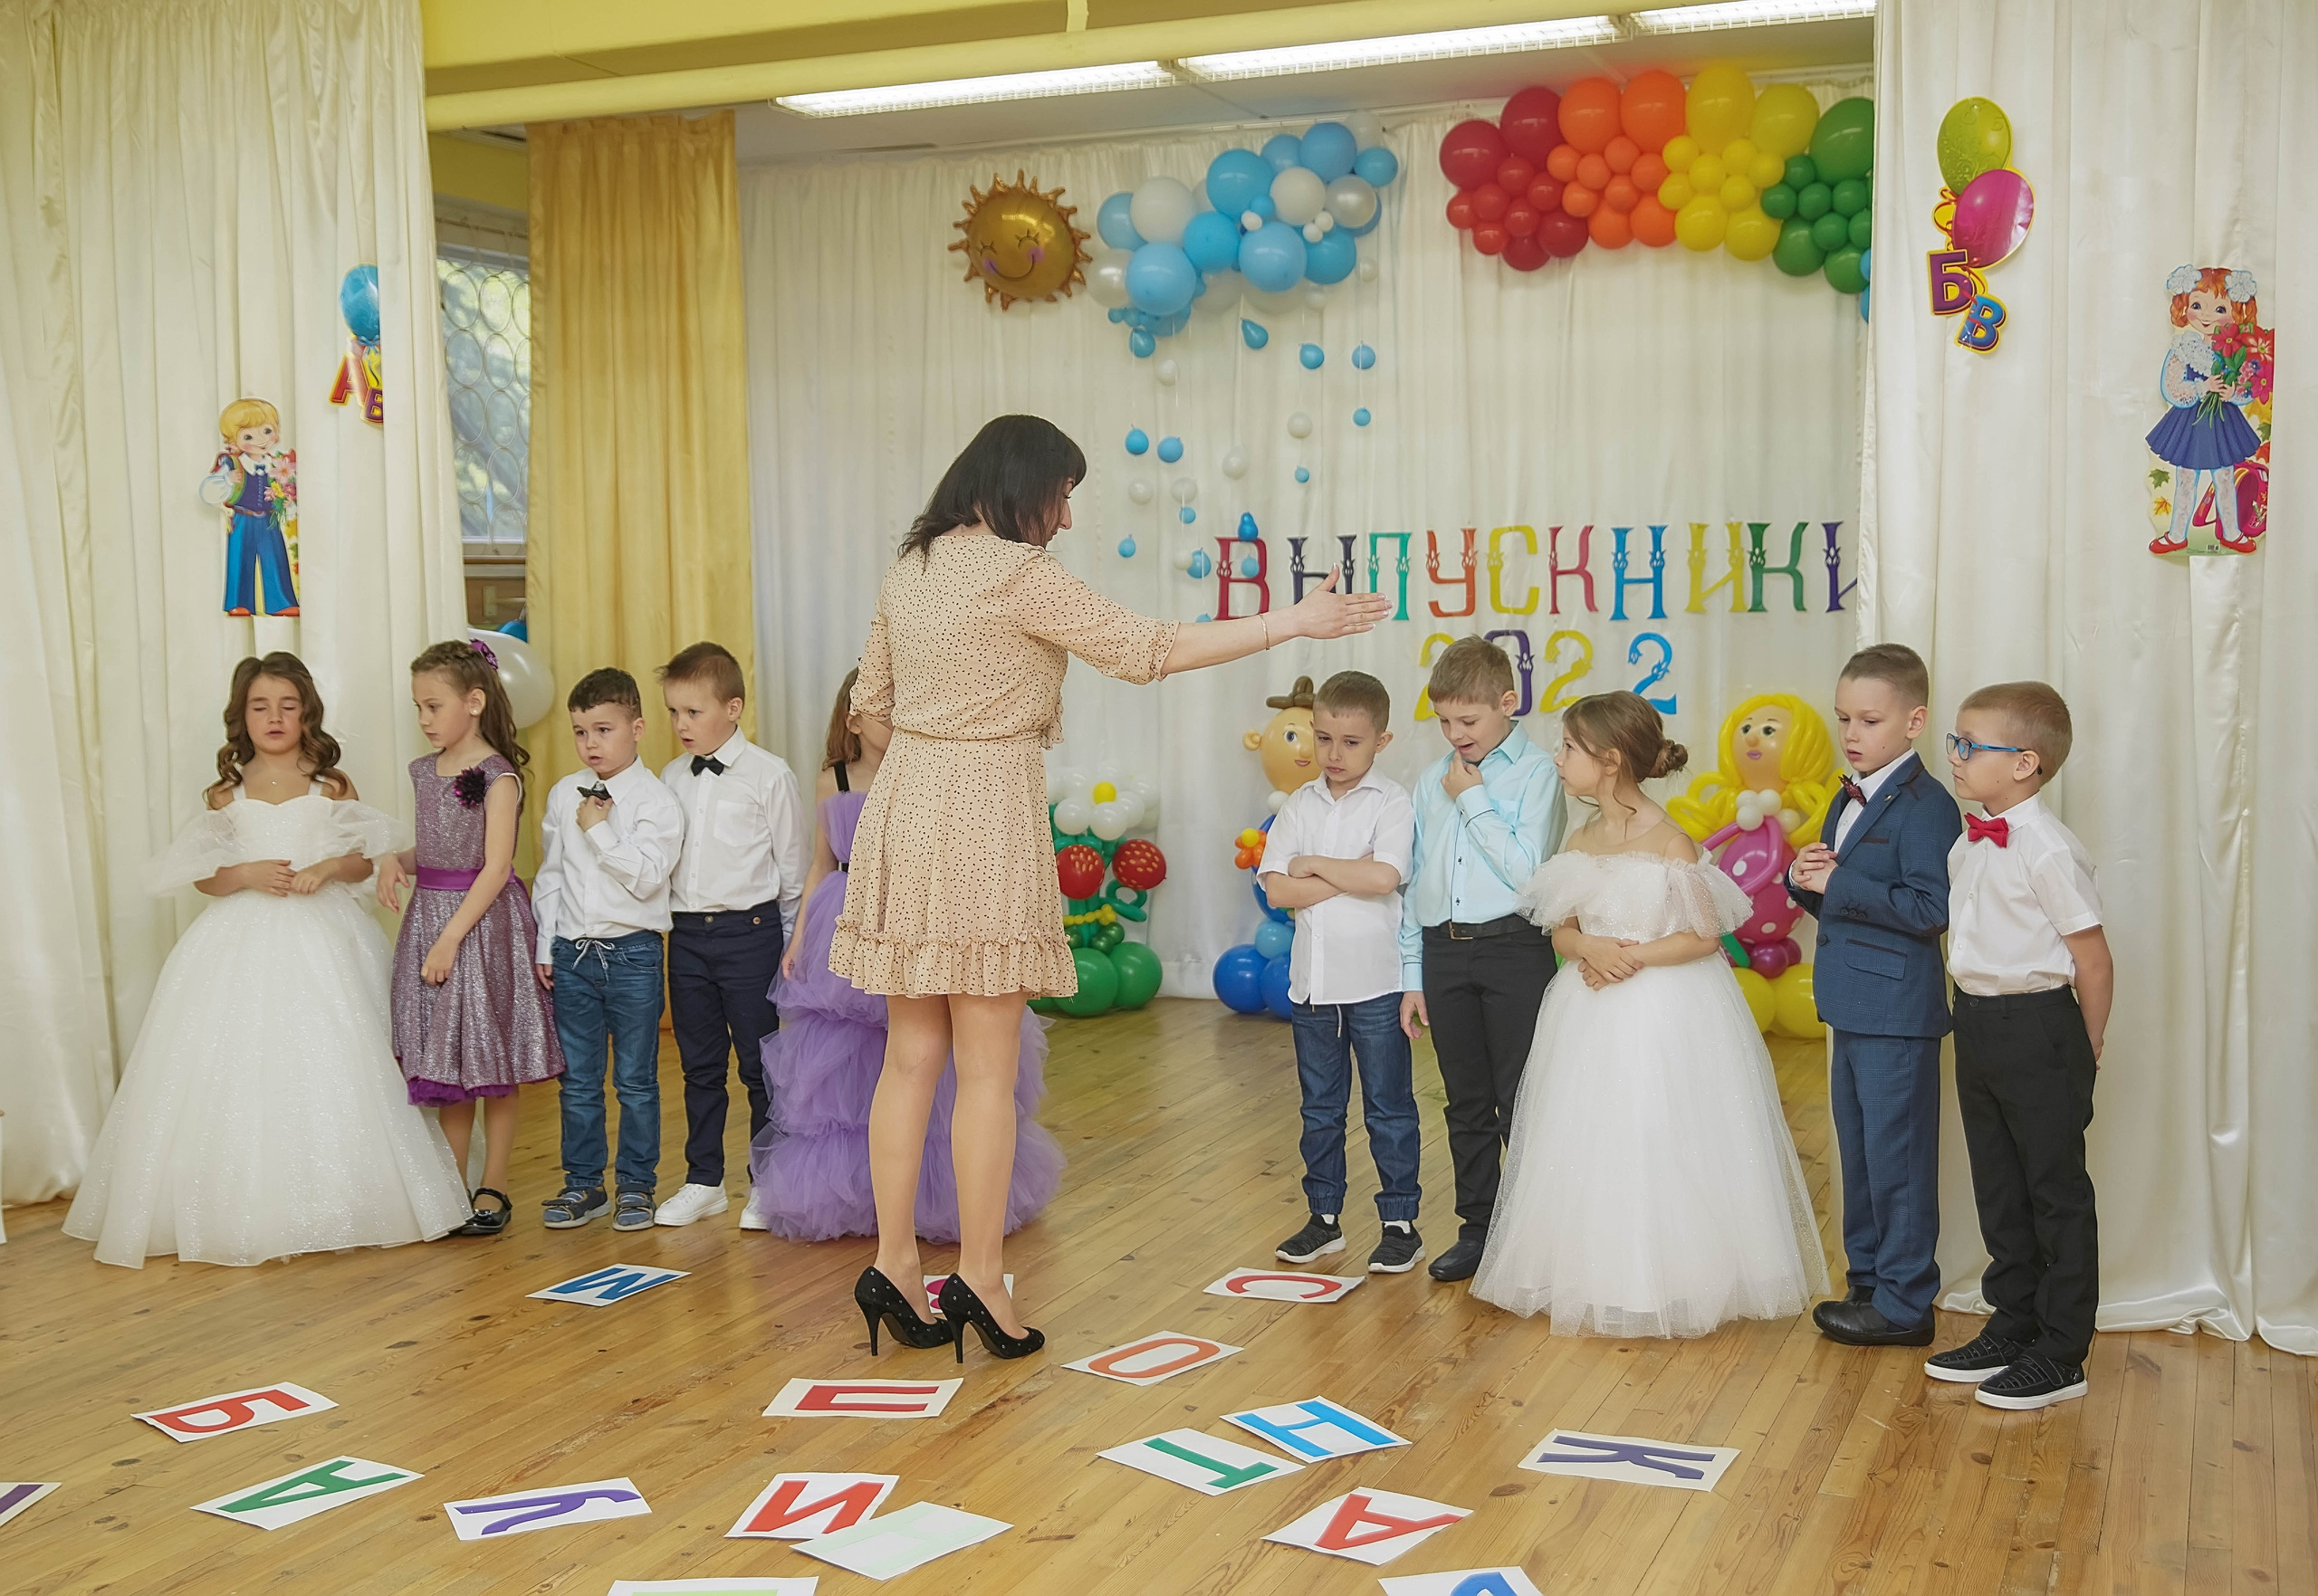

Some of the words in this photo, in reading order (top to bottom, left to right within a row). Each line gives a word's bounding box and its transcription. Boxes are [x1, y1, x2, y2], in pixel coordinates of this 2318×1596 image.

[147, 1389, 311, 1434] Б
[1233, 1400, 1398, 1457] Н
[1537, 1435, 1716, 1480] К
[216, 1460, 409, 1514] А
[1314, 1493, 1465, 1551] А
